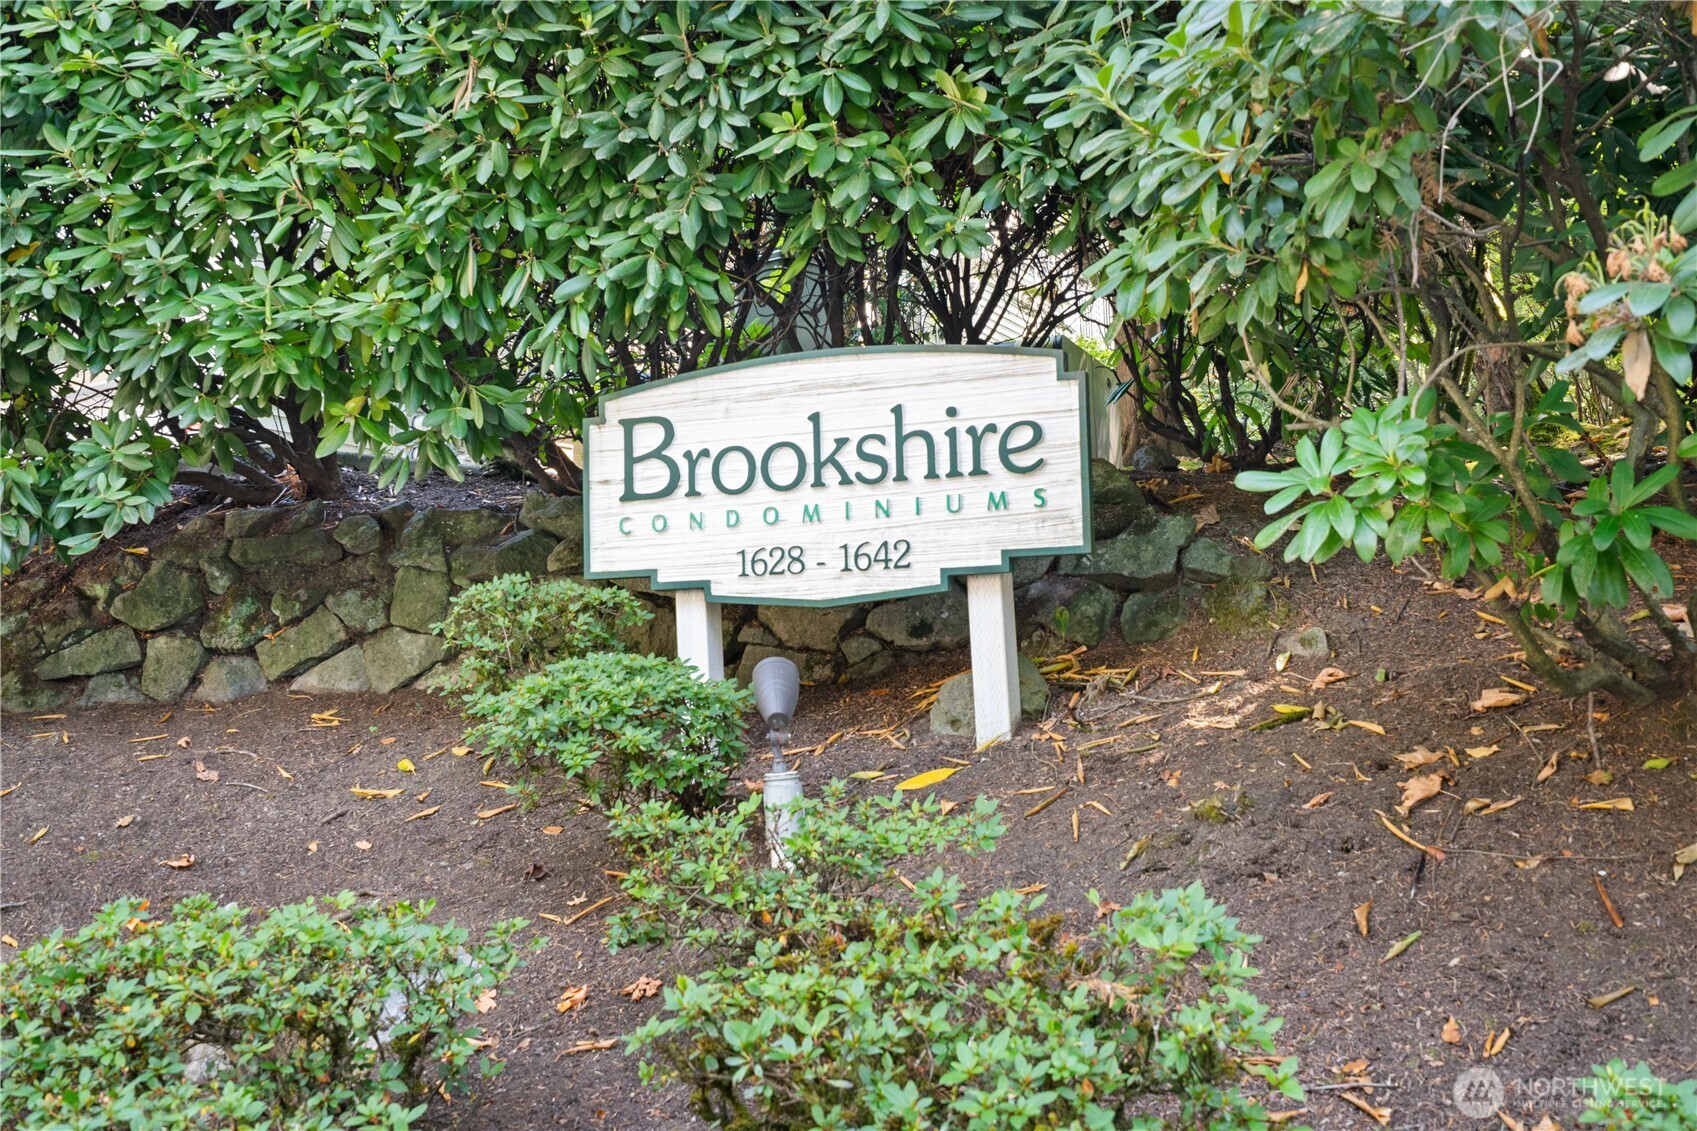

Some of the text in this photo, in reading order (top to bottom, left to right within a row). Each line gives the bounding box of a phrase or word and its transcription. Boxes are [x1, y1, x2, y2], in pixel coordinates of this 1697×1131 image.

[618, 403, 1045, 501] Brookshire
[619, 488, 1047, 535] CONDOMINIUMS
[737, 545, 806, 577] 1628
[839, 539, 912, 572] 1642
